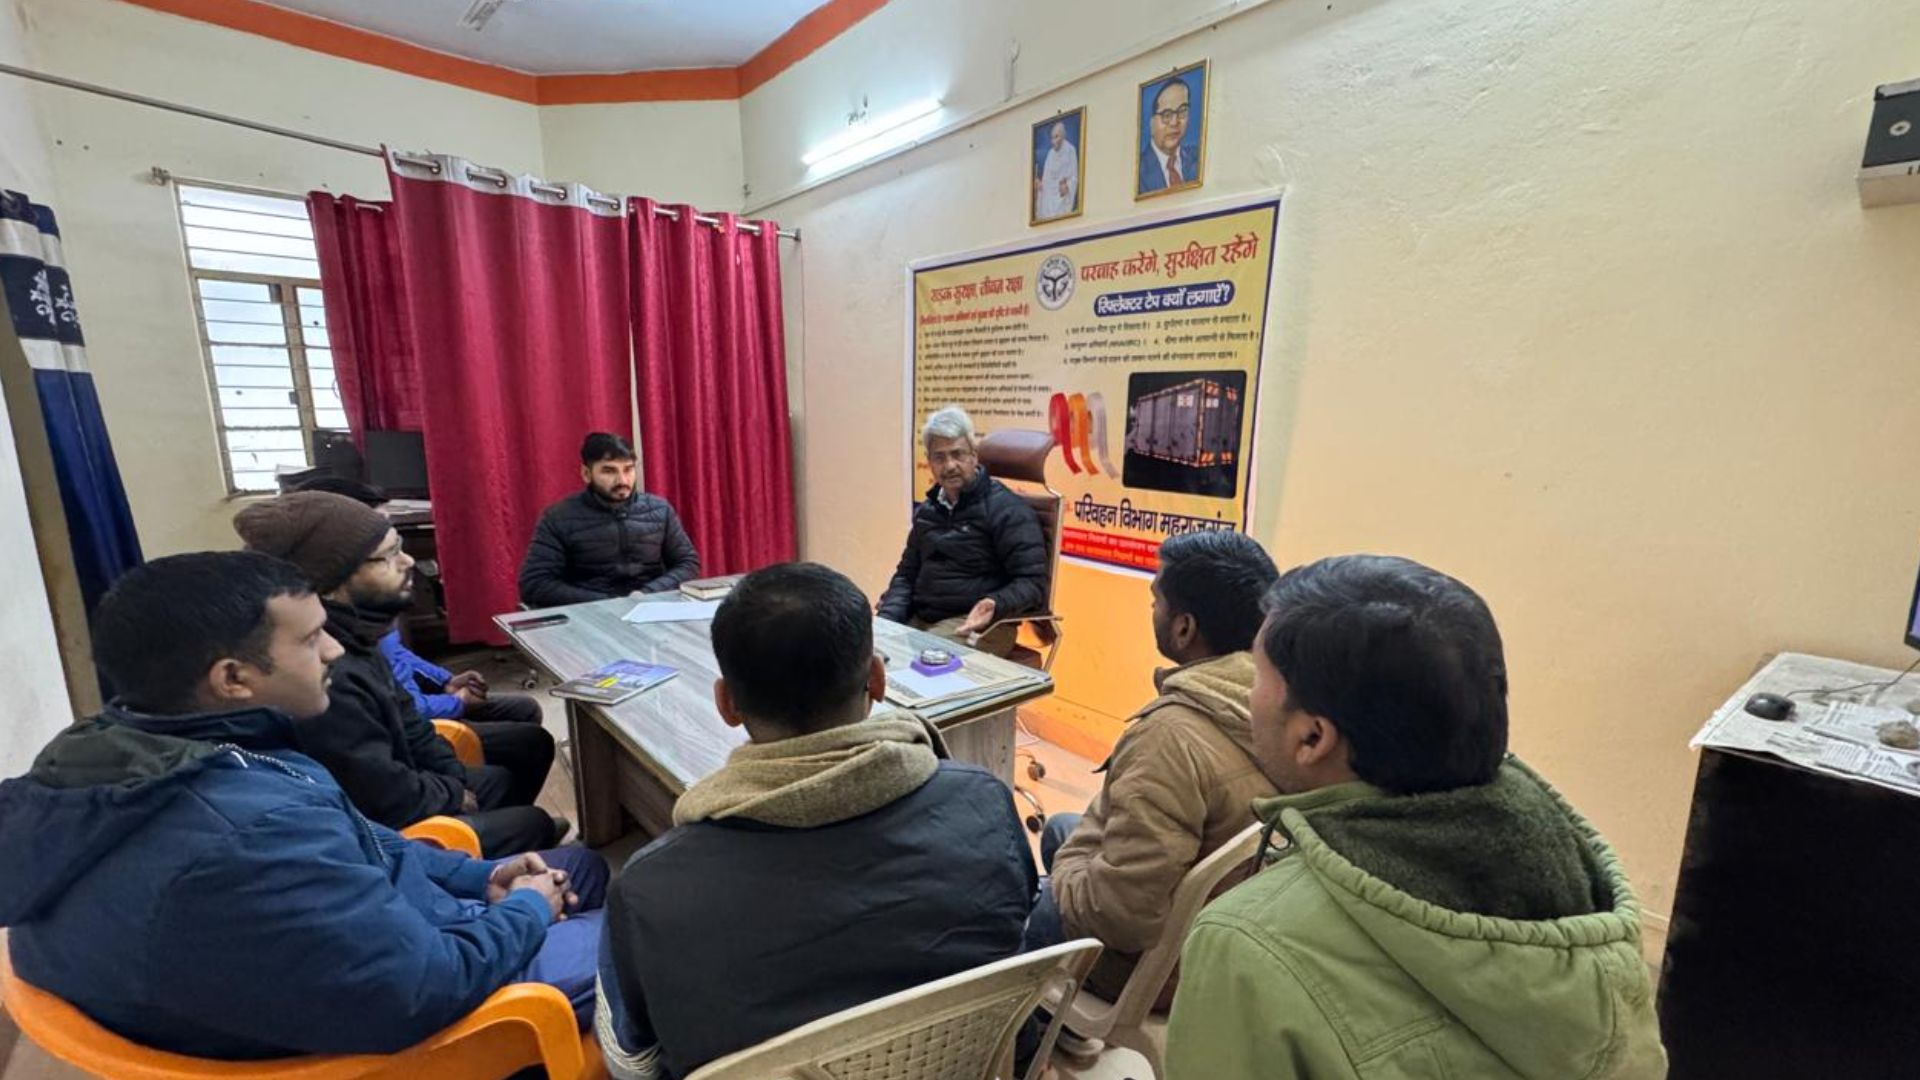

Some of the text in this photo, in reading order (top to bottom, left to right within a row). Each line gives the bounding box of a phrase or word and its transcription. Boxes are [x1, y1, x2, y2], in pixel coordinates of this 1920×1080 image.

[1080, 261, 1119, 282] परवाह
[1122, 249, 1160, 276] करेंगे,
[1164, 240, 1217, 279] सुरक्षित
[1220, 231, 1259, 264] रहेंगे
[1144, 291, 1161, 310] टेप
[1074, 493, 1117, 529] परिवहन
[1119, 498, 1158, 534] विभाग
